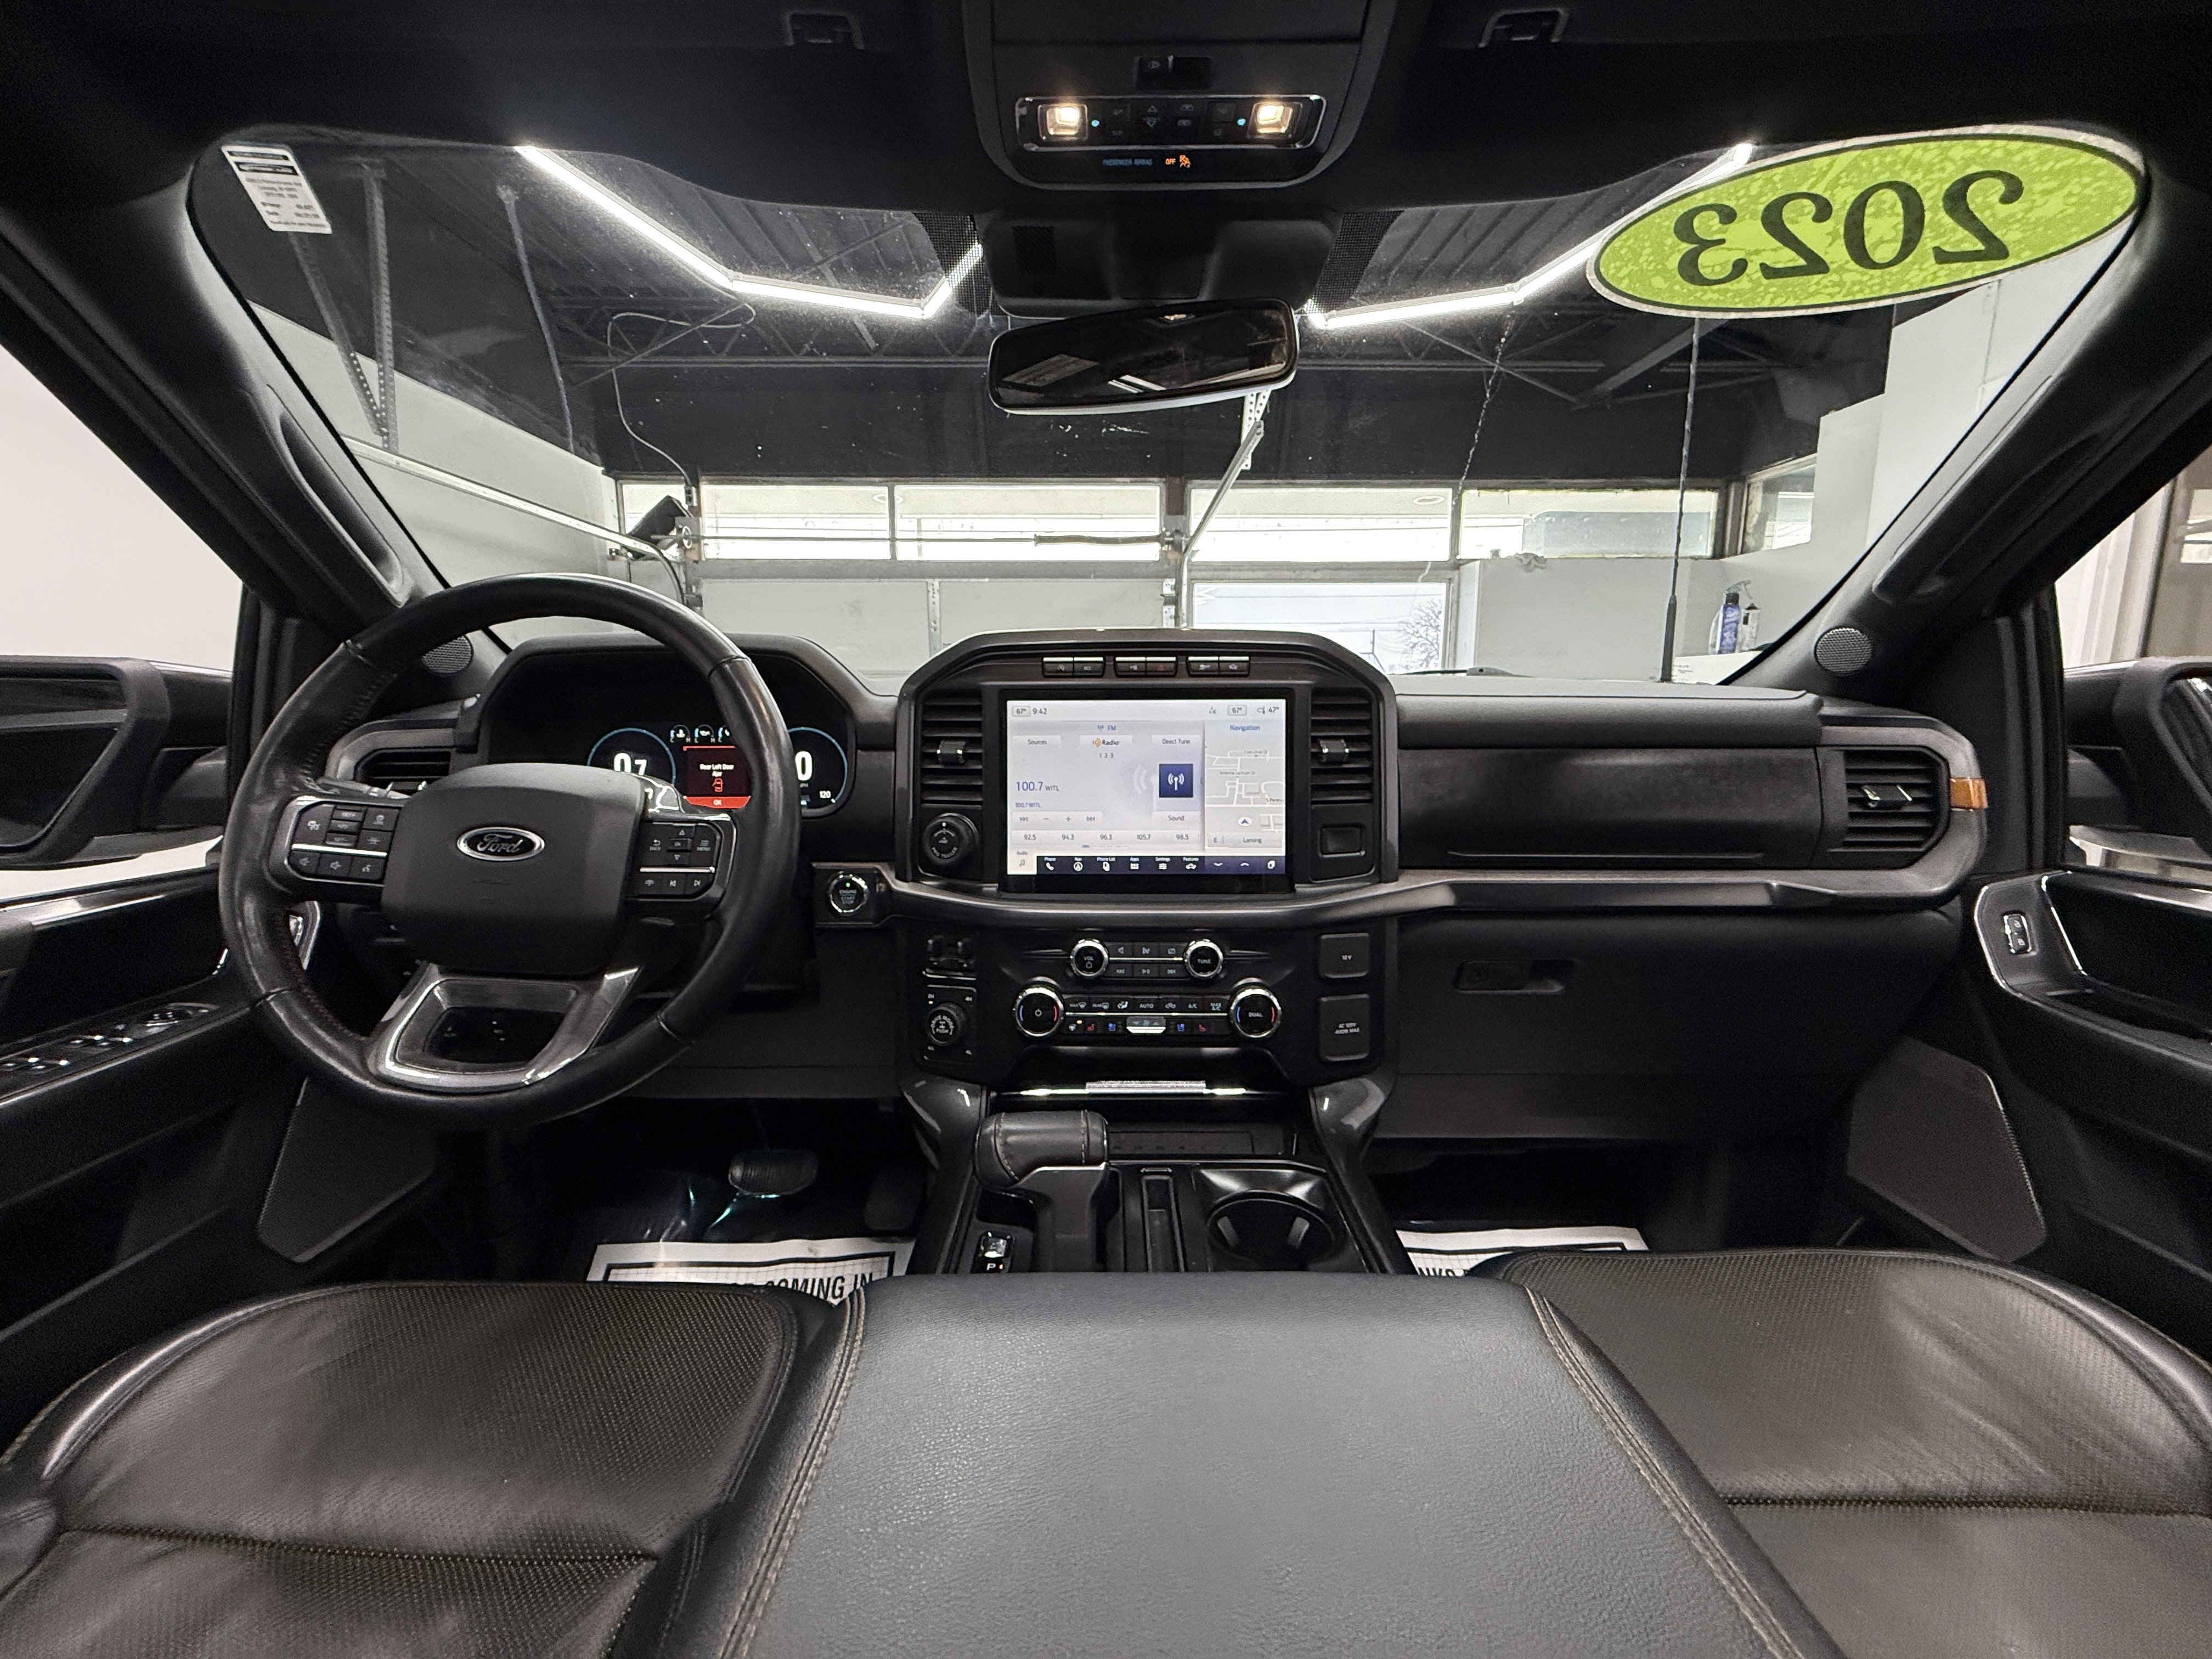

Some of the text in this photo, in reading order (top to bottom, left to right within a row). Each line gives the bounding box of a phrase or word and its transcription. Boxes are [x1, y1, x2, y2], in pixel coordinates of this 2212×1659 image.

[795, 751, 812, 781] 0
[1016, 781, 1043, 792] 100.7
[477, 833, 523, 853] Ford
[766, 1276, 845, 1300] MING
